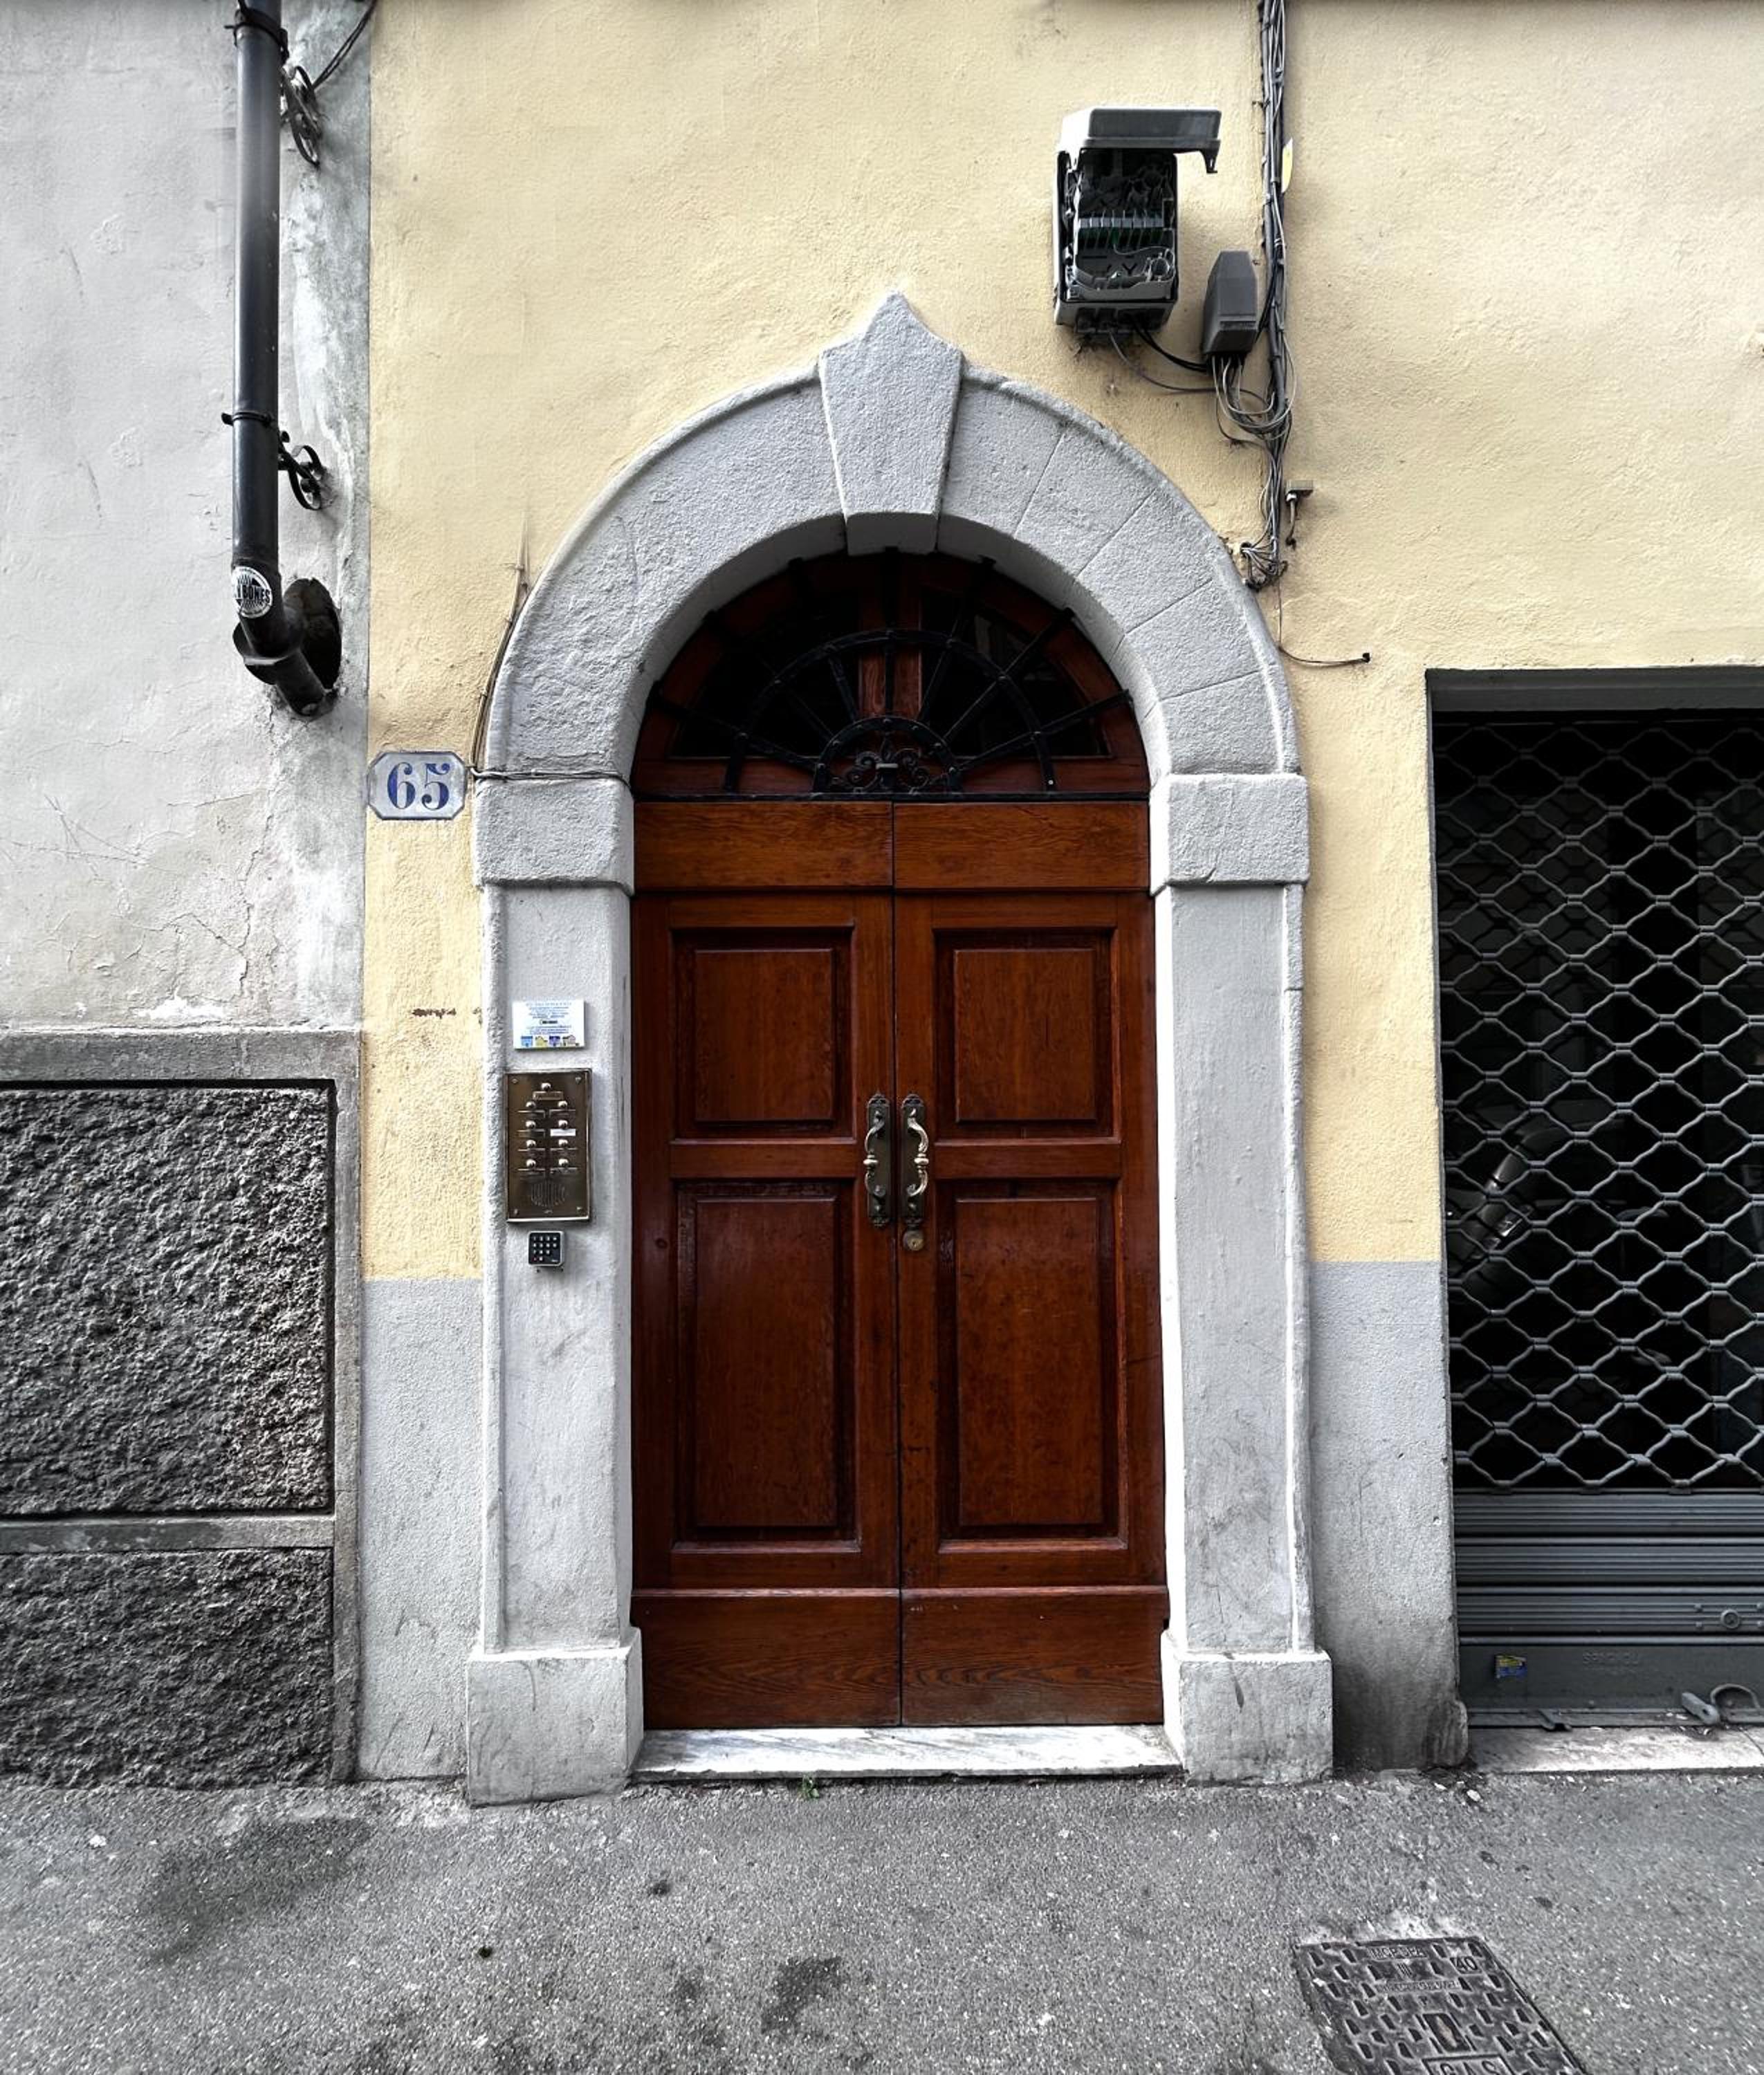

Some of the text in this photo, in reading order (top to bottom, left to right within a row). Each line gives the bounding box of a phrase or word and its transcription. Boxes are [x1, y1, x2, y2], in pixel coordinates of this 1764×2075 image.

[387, 762, 450, 811] 65
[1455, 1956, 1478, 1971] 40
[1440, 2060, 1500, 2075] GAS
